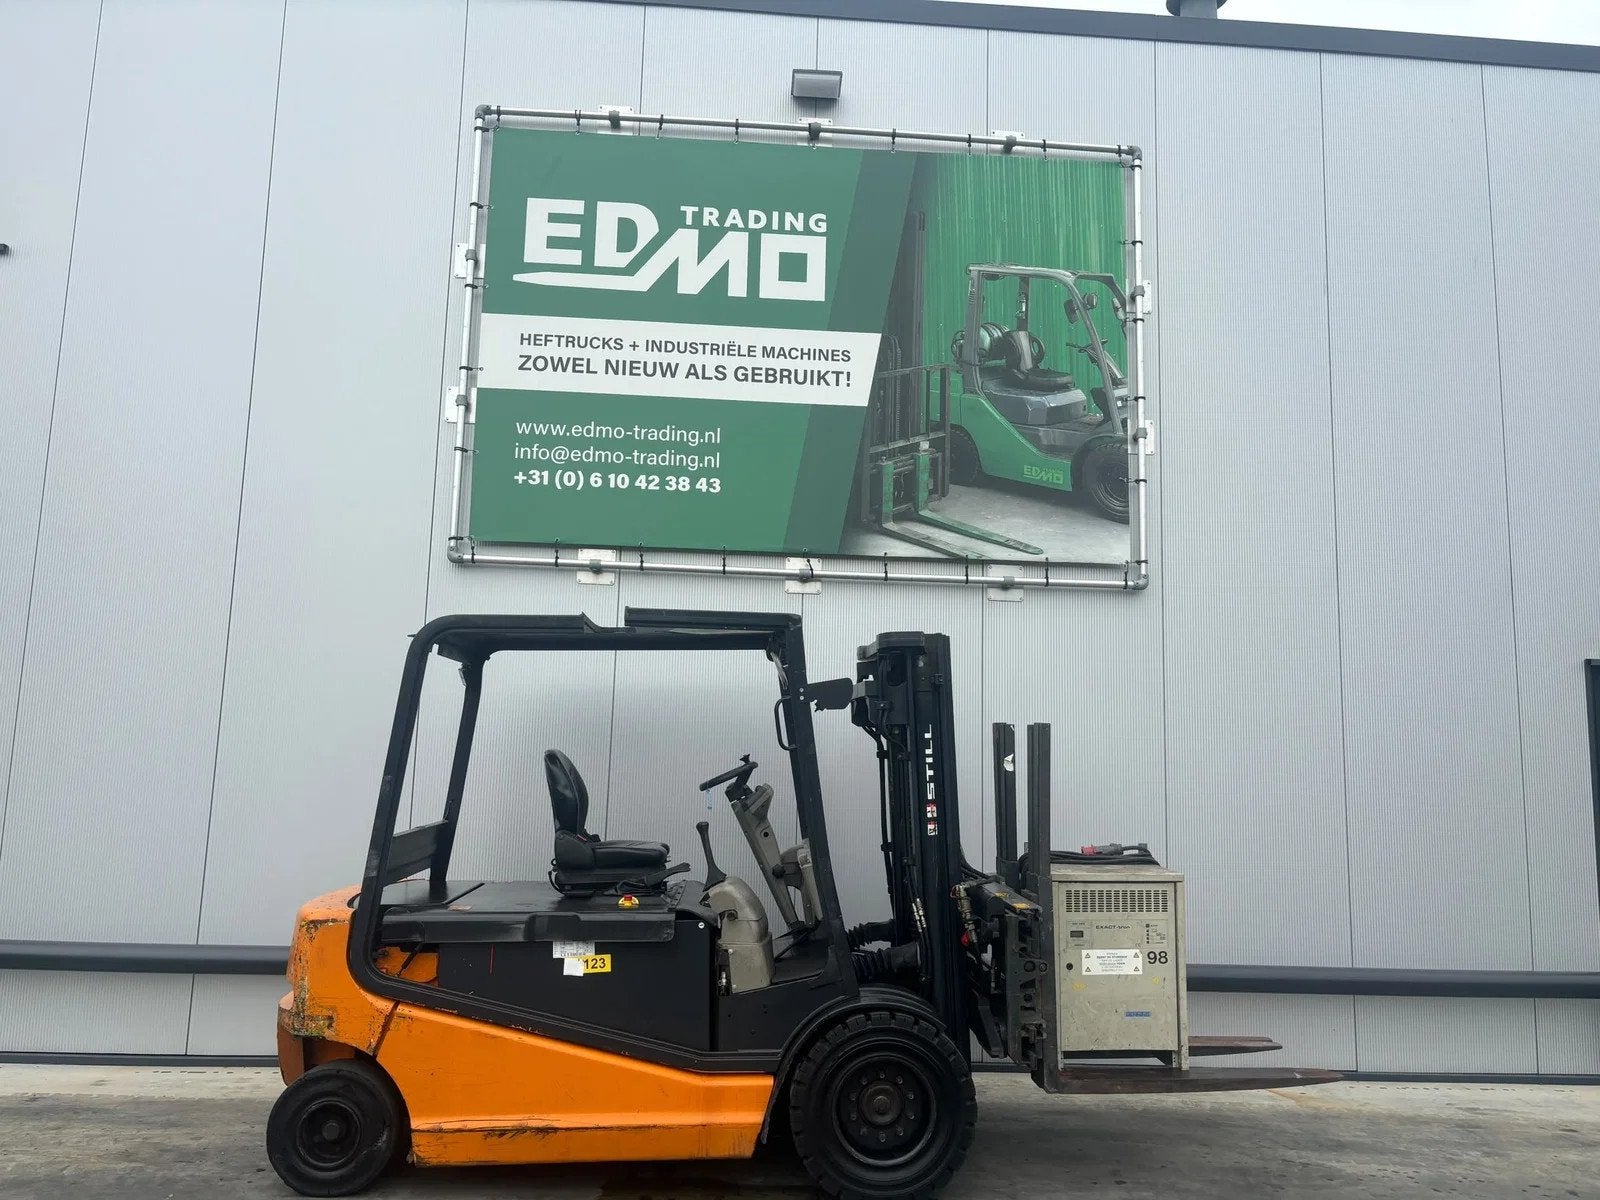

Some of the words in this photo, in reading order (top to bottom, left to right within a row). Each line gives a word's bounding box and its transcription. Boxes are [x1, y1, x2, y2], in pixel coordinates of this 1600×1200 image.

[680, 205, 827, 233] TRADING
[513, 197, 827, 301] EDMO
[519, 332, 624, 351] HEFTRUCKS
[629, 340, 640, 352] +
[645, 338, 757, 358] INDUSTRIËLE
[761, 345, 851, 363] MACHINES
[518, 354, 598, 375] ZOWEL
[604, 358, 680, 379] NIEUW
[684, 363, 728, 382] ALS
[733, 365, 851, 388] GEBRUIKT!
[515, 420, 721, 447] www.edmo-trading.nl
[514, 442, 720, 471] info@edmo-trading.nl
[514, 469, 549, 486] +31
[554, 469, 584, 491] (0)
[589, 472, 603, 488] 6
[608, 473, 630, 489] 10
[634, 474, 660, 490] 42
[665, 476, 691, 492] 38
[695, 477, 721, 493] 43
[1023, 464, 1064, 484] EDMO
[924, 723, 936, 800] STILL
[1147, 950, 1168, 965] 98
